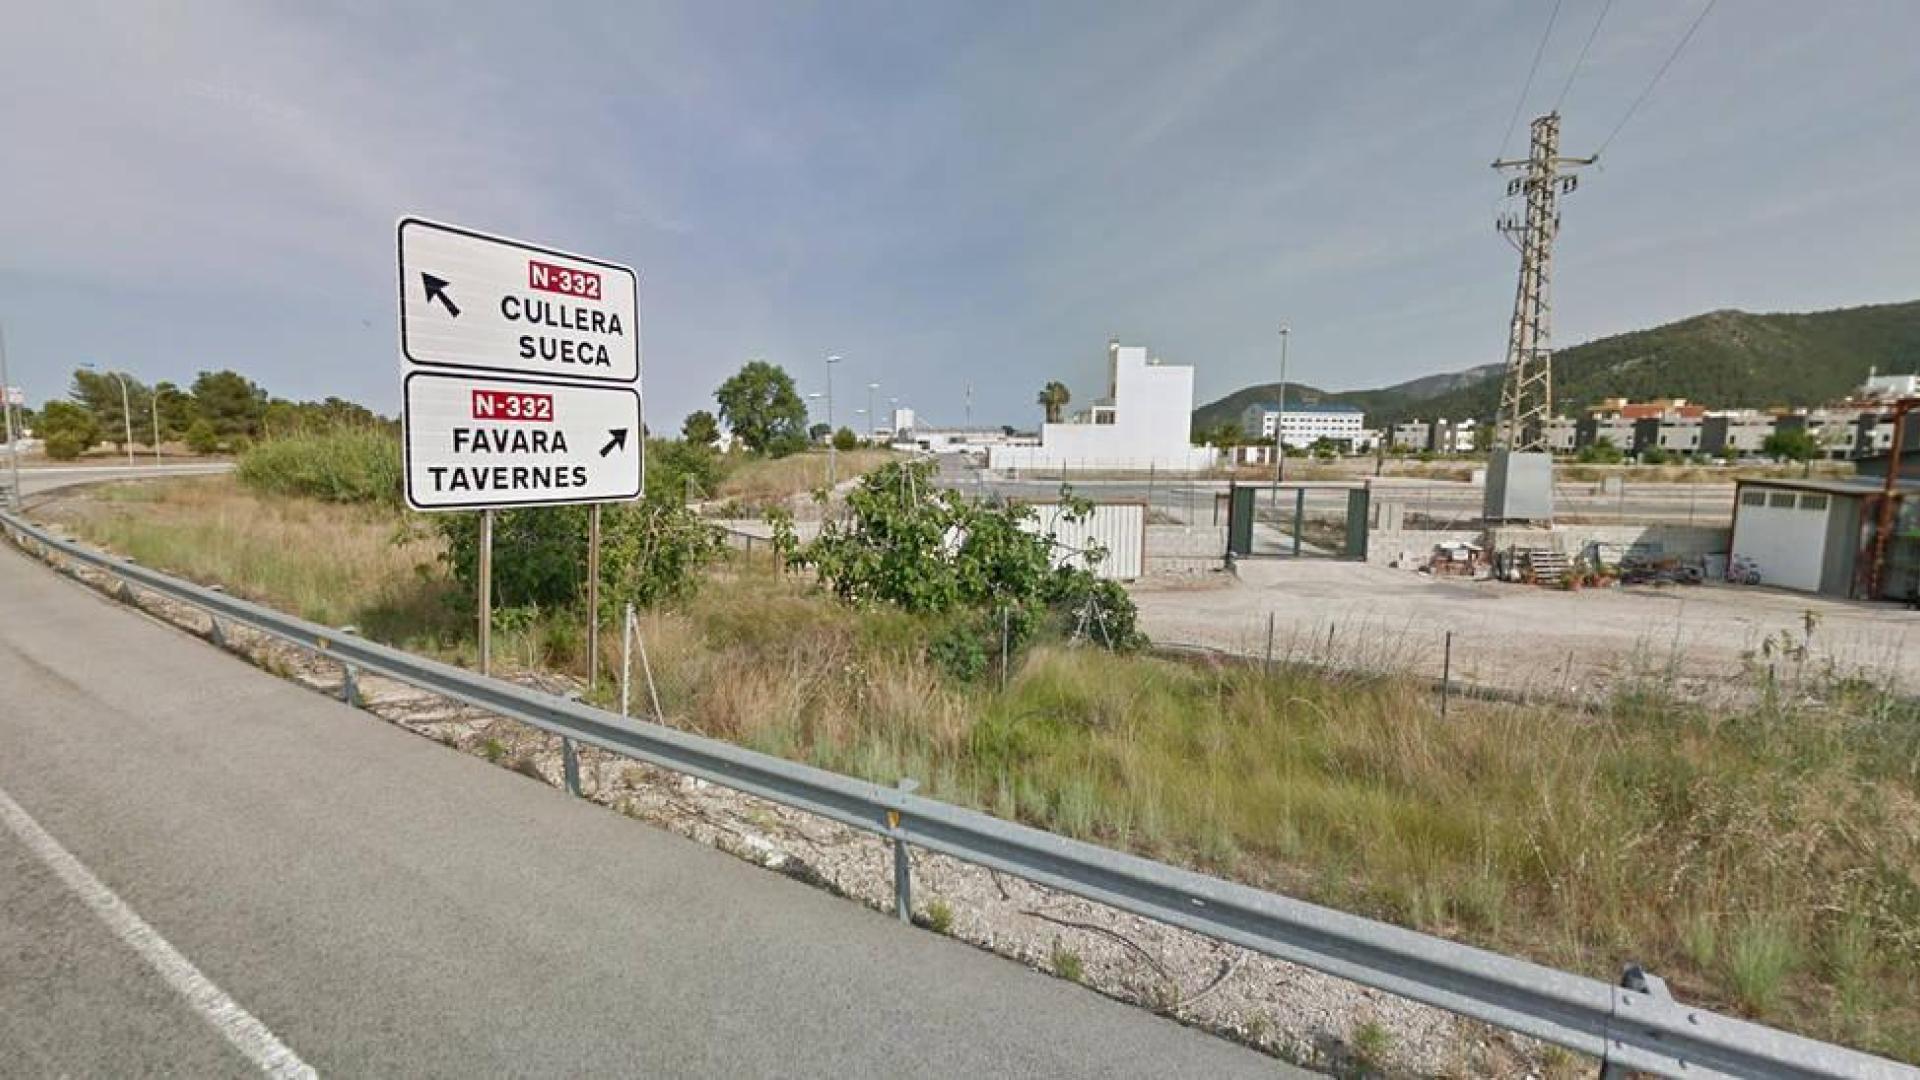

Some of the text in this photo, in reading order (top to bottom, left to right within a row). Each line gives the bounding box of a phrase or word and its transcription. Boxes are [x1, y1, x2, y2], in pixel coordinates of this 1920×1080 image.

[531, 265, 600, 297] N-332
[501, 296, 623, 335] CULLERA
[519, 336, 611, 367] SUECA
[476, 394, 551, 418] N-332
[453, 428, 568, 453] FAVARA
[428, 466, 588, 491] TAVERNES
